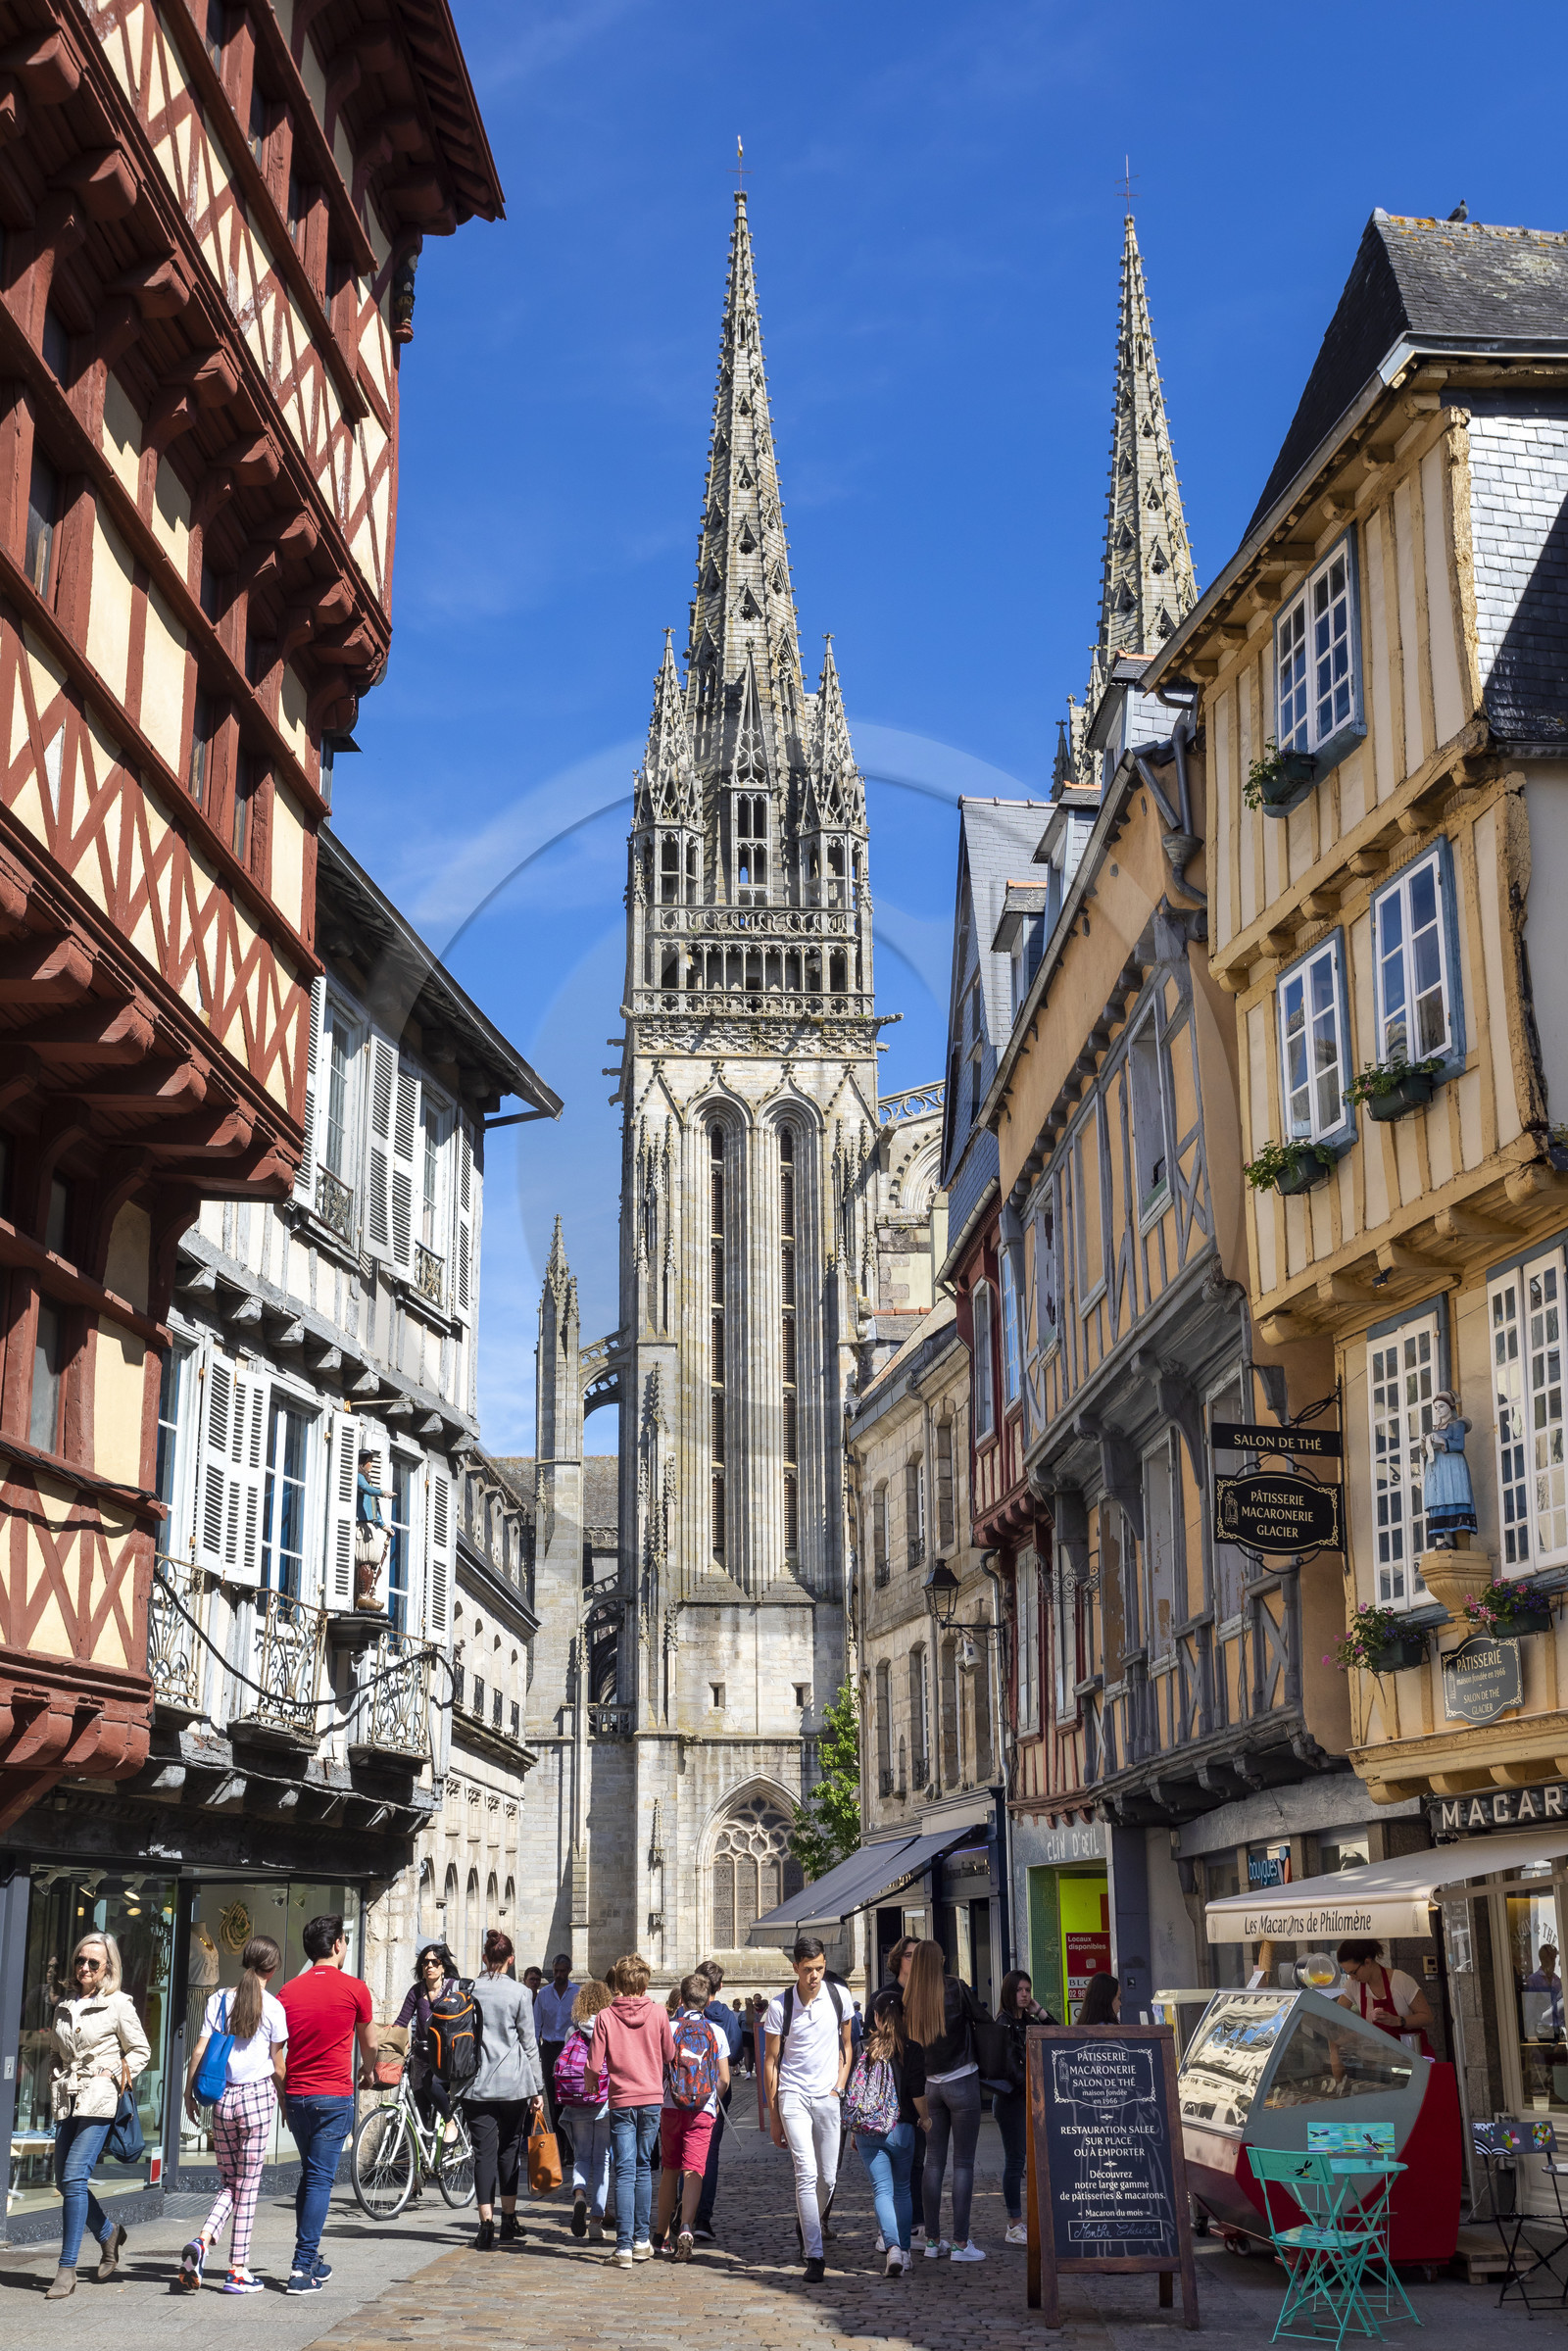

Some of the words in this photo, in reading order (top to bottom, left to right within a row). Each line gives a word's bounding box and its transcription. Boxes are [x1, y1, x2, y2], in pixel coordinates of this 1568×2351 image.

[1234, 1434, 1274, 1447] SALON
[1279, 1438, 1296, 1448] DE
[1298, 1438, 1322, 1450] THÉ
[1250, 1490, 1304, 1505] PÂTISSERIE
[1241, 1506, 1314, 1522] MACARONERIE
[1256, 1525, 1298, 1538] GLACIER
[1456, 1649, 1502, 1673] PÂTISSERIE
[1456, 1676, 1471, 1686] maison
[1472, 1672, 1487, 1684] fondée
[1494, 1667, 1506, 1678] 1966
[1463, 1692, 1480, 1704] SALON
[1481, 1690, 1489, 1700] DE
[1489, 1686, 1500, 1698] THÉ
[1472, 1703, 1494, 1715] GLACIER
[1443, 1787, 1563, 1830] MACAR
[1249, 1855, 1278, 1885] bouygues
[1245, 1917, 1257, 1935] Les
[1259, 1915, 1303, 1936] Macarons
[1307, 1912, 1317, 1933] de
[1320, 1910, 1371, 1932] Philomène
[1078, 2051, 1127, 2061] PÂTISSERIE
[1070, 2065, 1136, 2075] MACARONERIE
[1118, 2077, 1136, 2086] THÉ
[1060, 2126, 1127, 2134] RESTAURATION
[1090, 2147, 1097, 2156] À
[1099, 2180, 1118, 2190] large
[1120, 2181, 1149, 2190] gamme
[1072, 2191, 1114, 2202] pâtisseries
[1116, 2191, 1123, 2200] &
[1074, 2223, 1112, 2238] Menthe
